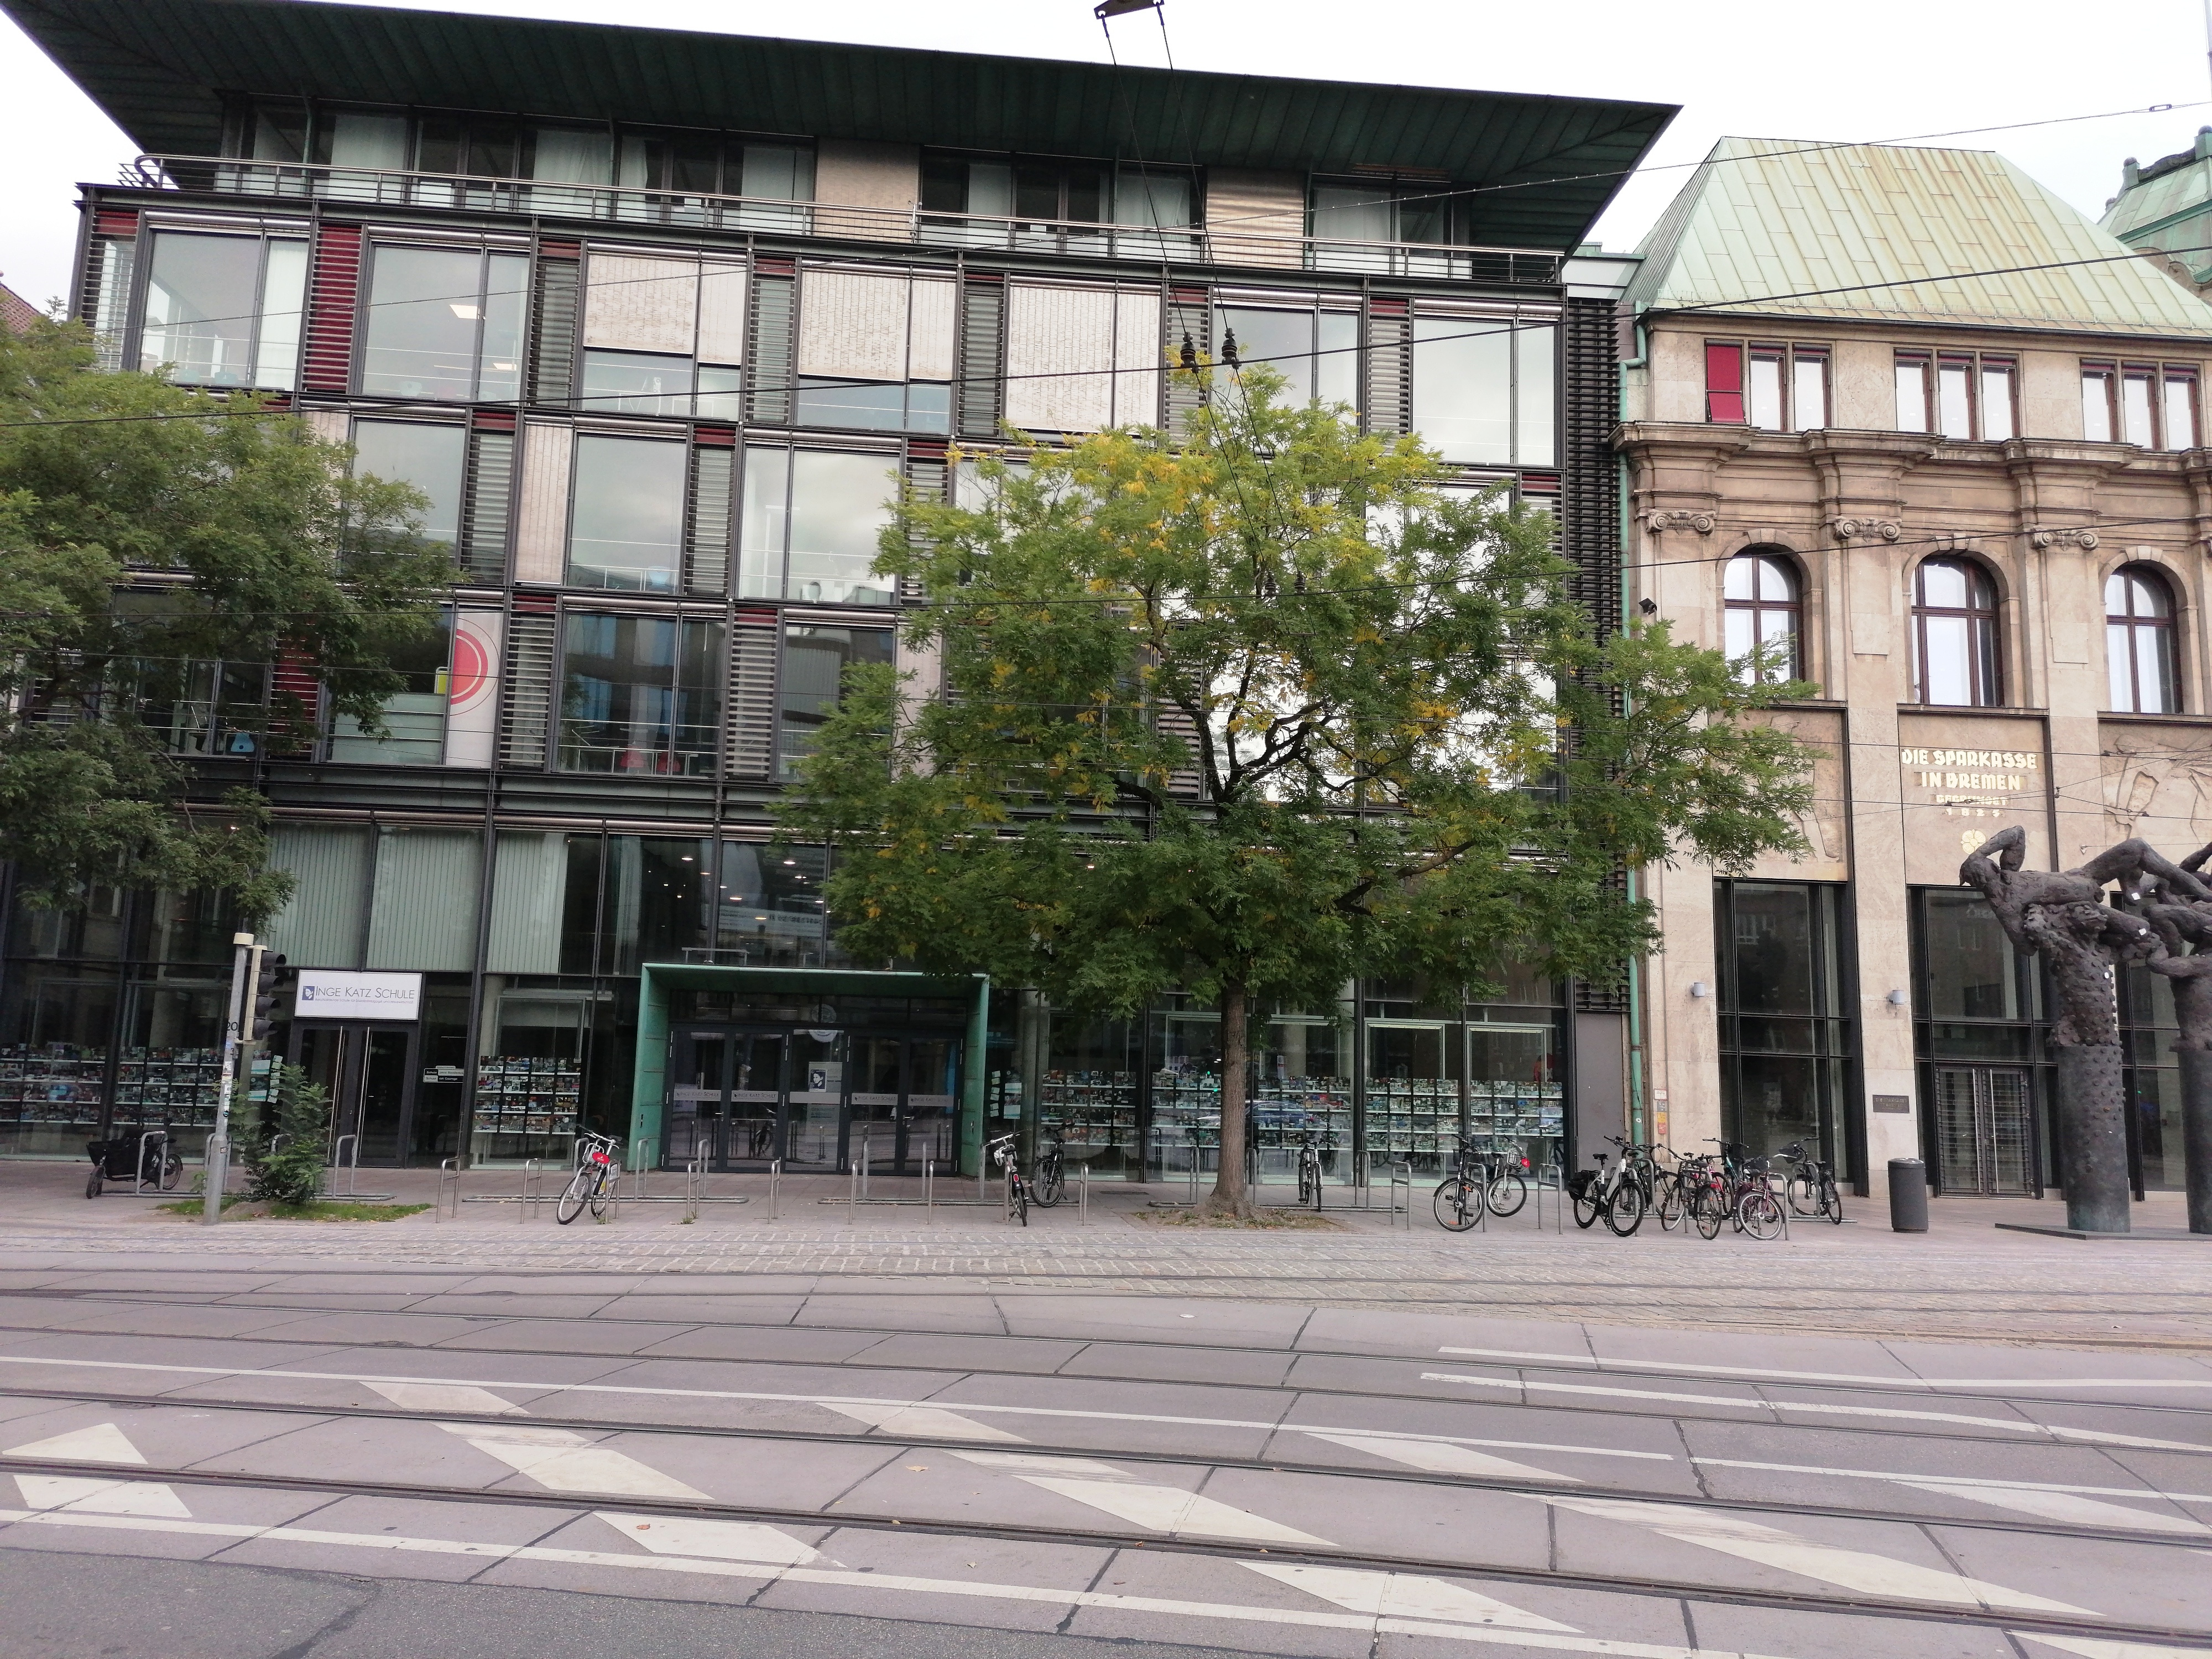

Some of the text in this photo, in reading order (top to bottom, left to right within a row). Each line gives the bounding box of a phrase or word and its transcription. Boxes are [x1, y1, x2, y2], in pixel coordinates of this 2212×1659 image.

[1901, 749, 2038, 769] DIE SPARKASSE
[1921, 771, 2021, 790] IN BREMEN
[315, 986, 415, 999] INGE KATZ SCHULE
